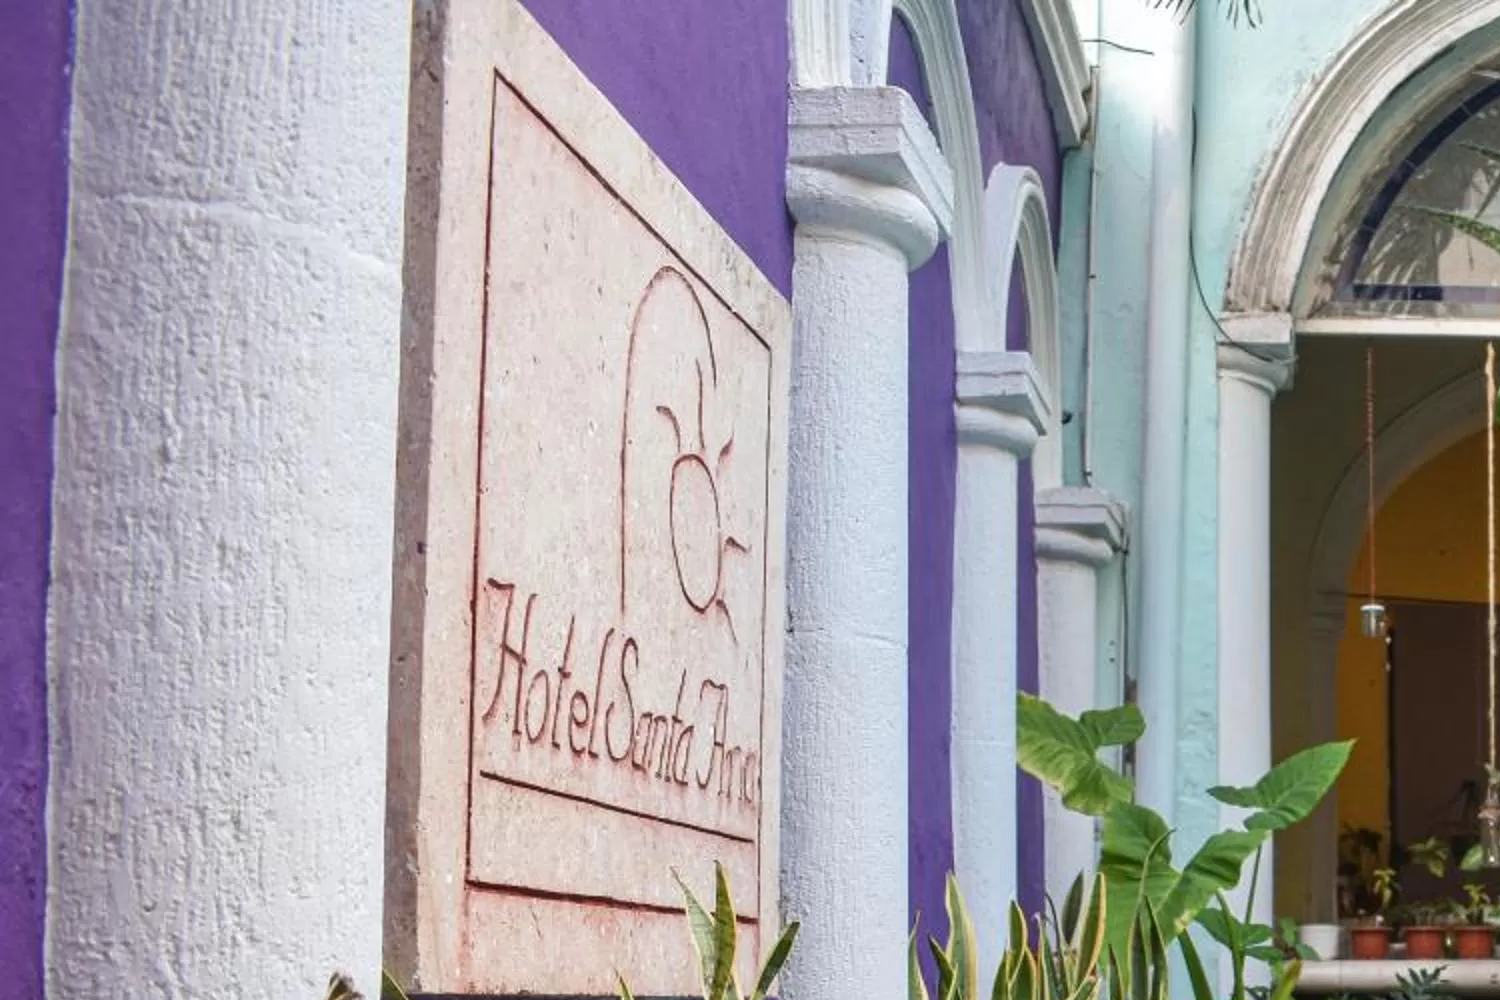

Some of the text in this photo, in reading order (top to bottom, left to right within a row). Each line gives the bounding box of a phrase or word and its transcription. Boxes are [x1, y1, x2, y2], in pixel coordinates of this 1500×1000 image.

[481, 577, 757, 802] Hotel Santa Ana
